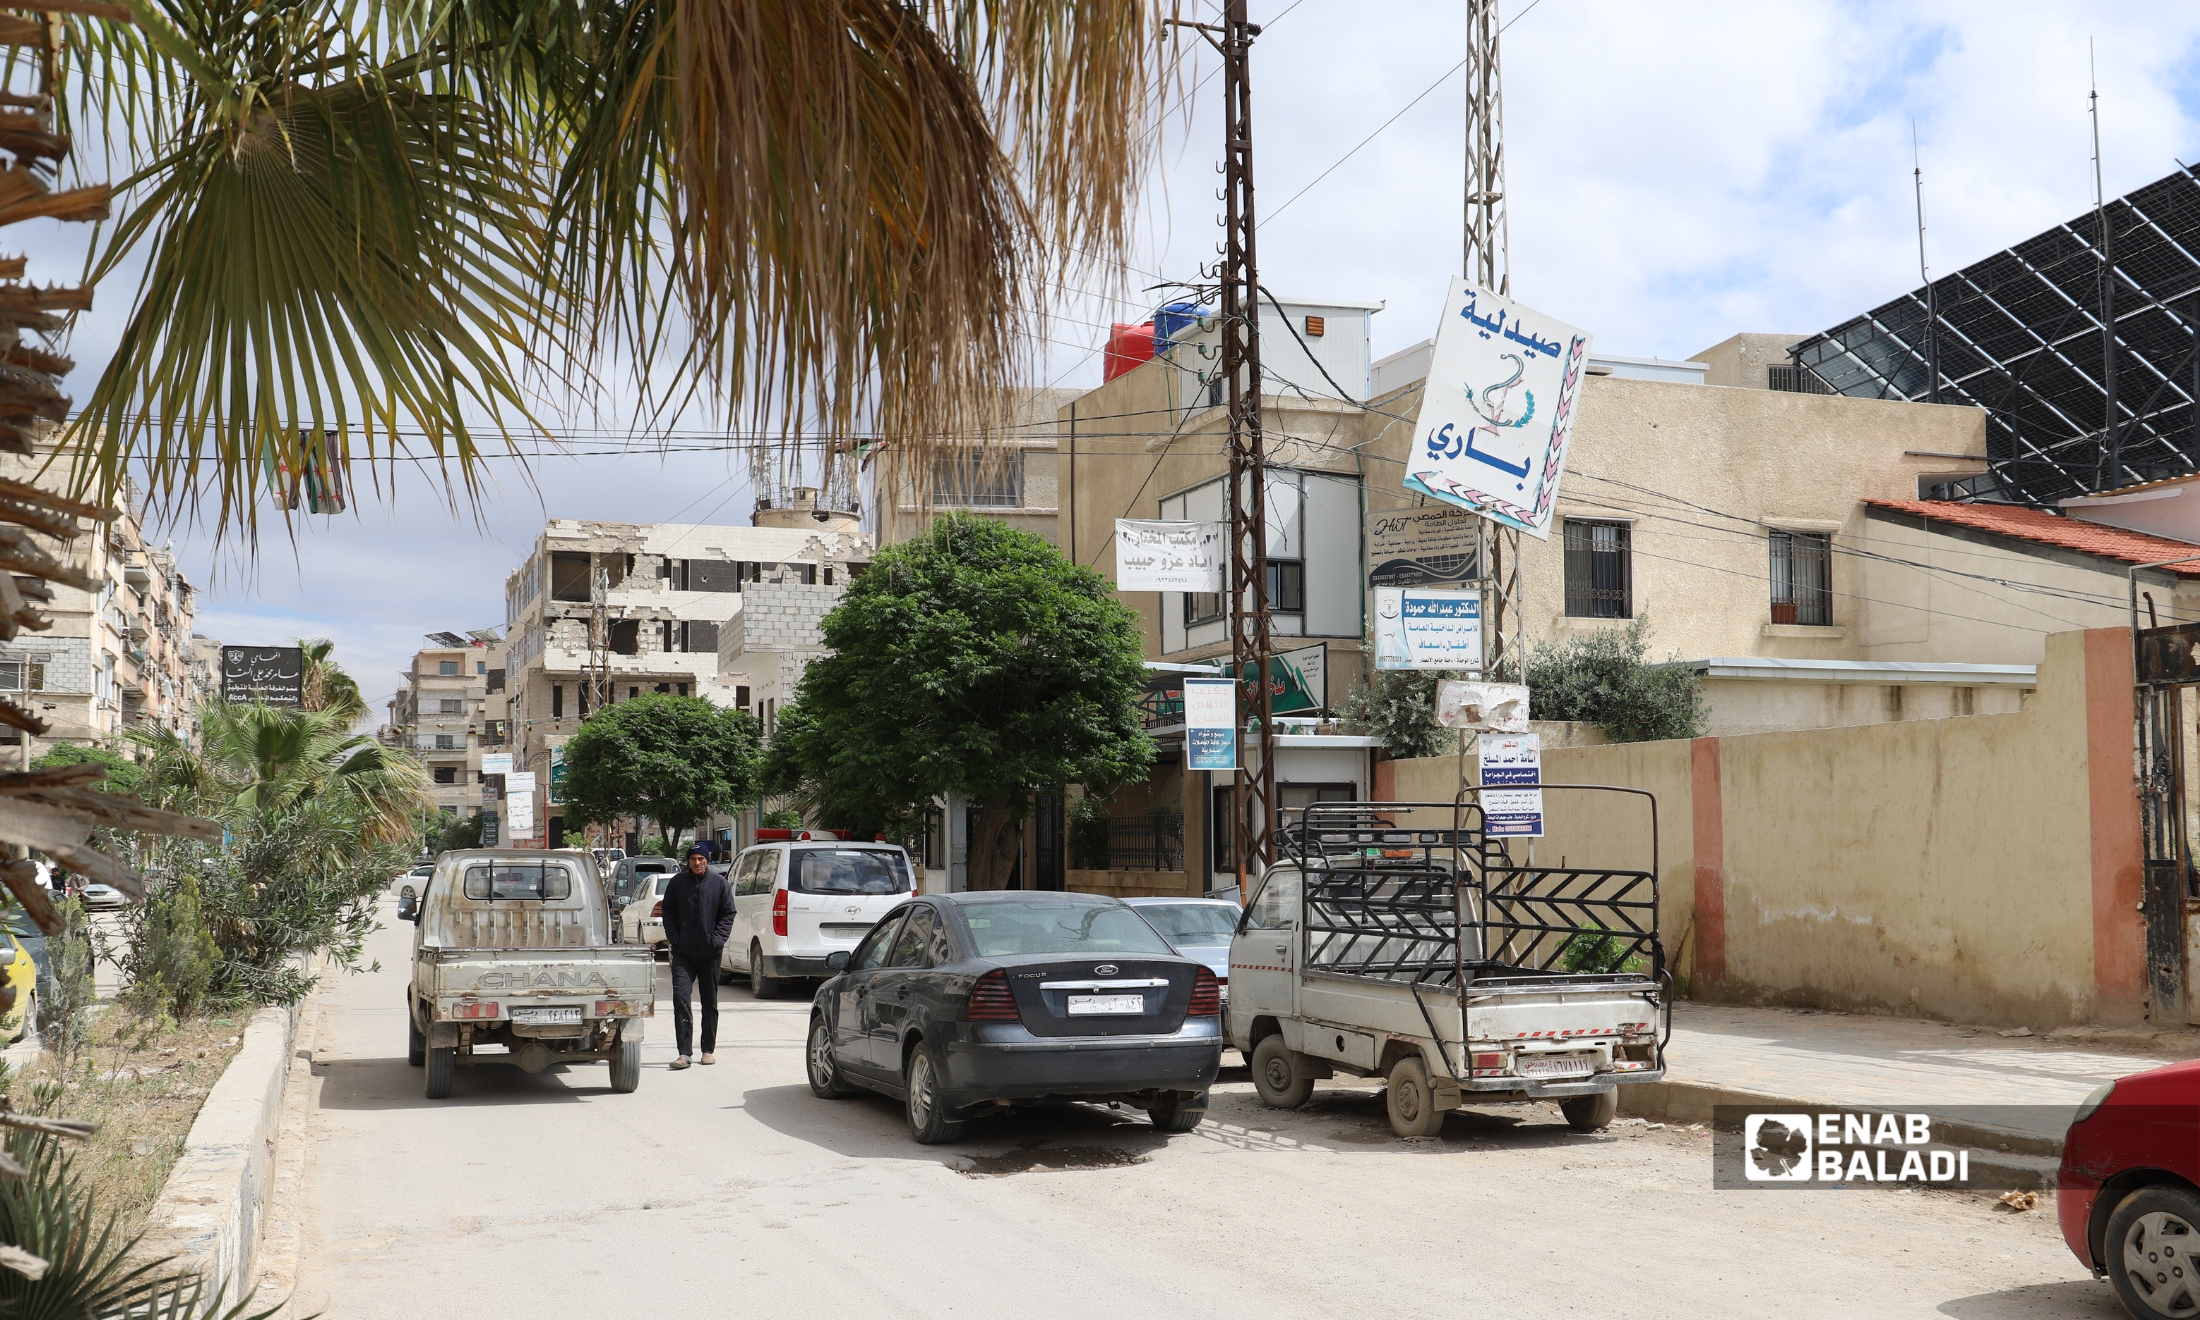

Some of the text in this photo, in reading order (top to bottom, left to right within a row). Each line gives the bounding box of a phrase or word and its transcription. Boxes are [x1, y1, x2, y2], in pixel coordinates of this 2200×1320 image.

[1460, 289, 1562, 359] صيدلية
[1427, 423, 1531, 491] باري
[1412, 510, 1447, 525] الحمصي
[1447, 517, 1467, 527] لحلول
[1133, 529, 1197, 549] مكتب المختار
[1124, 556, 1156, 571] حبيب
[1160, 552, 1184, 571] عزو
[1405, 600, 1479, 617] الدكتور عبد الله حمودة
[1408, 622, 1430, 632] العامة
[1430, 622, 1456, 634] الداخلية
[1446, 638, 1469, 652] أطفال
[250, 648, 281, 666] المحامي
[1434, 657, 1444, 665] جامع
[1470, 656, 1479, 665] شارع
[268, 667, 300, 681] عامر
[226, 683, 248, 692] للتوفيق
[269, 684, 285, 692] الغرفة
[1191, 685, 1229, 697] مكتب
[269, 694, 298, 702] والتحكيم
[1214, 731, 1225, 739] بيع
[1501, 740, 1519, 750] الدكتور
[1484, 770, 1504, 779] الجراحة
[1505, 770, 1512, 780] في
[478, 971, 608, 987] CHANA
[1524, 1061, 1537, 1069] دمشق
